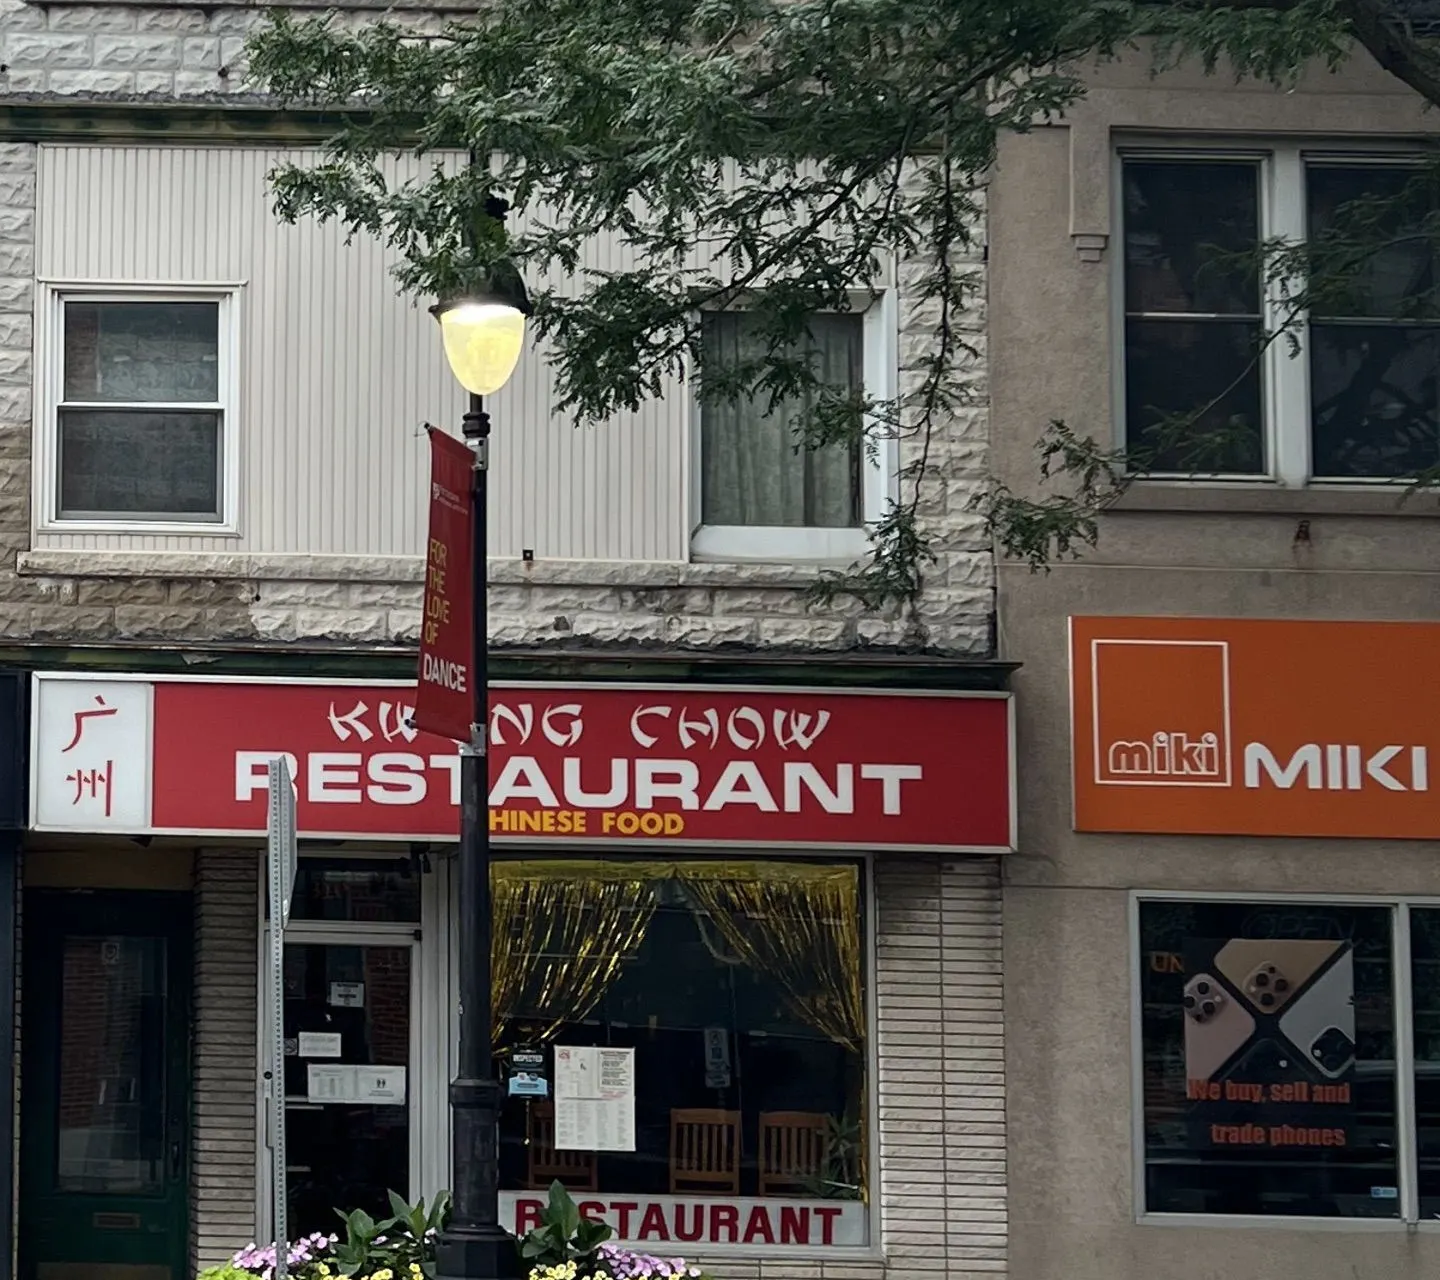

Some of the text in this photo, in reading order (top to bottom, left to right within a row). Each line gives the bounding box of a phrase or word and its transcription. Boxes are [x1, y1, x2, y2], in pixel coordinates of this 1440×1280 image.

[429, 538, 447, 568] FOR
[428, 566, 445, 594] THE
[426, 595, 450, 624] LOVE
[424, 622, 439, 645] OF
[423, 652, 467, 692] DANCE
[327, 700, 831, 751] KWNG CHOW
[1109, 731, 1428, 791] miki MIKI
[488, 809, 685, 835] HINESE FOOD
[1187, 1079, 1221, 1100] We
[1270, 1081, 1309, 1102] sell
[1312, 1082, 1350, 1103] and
[1212, 1123, 1346, 1146] trade phones
[515, 1199, 843, 1245] RSTAURANT
